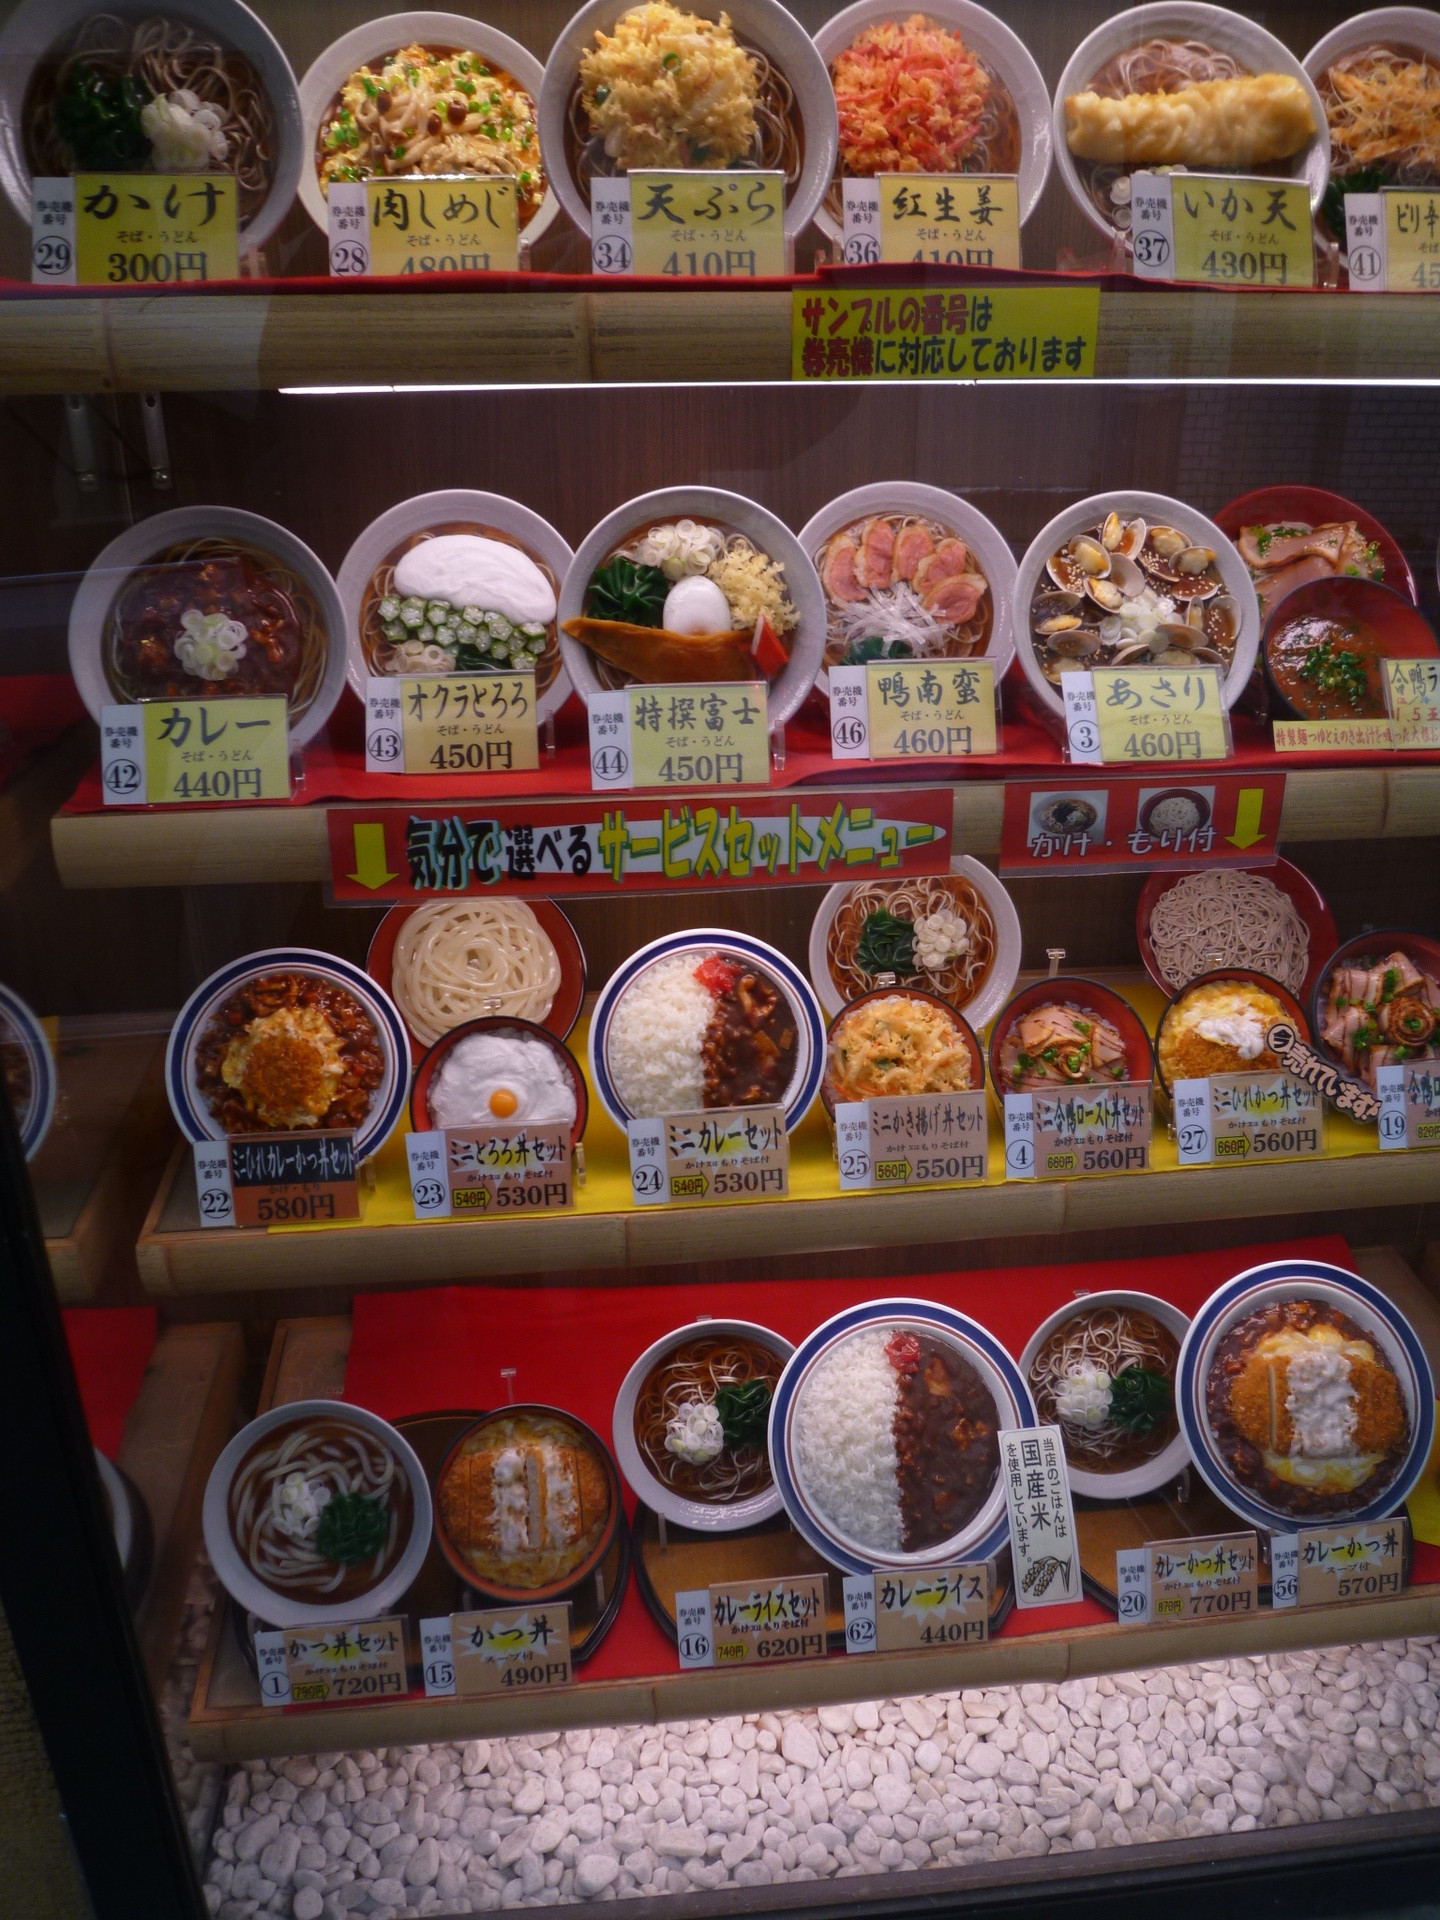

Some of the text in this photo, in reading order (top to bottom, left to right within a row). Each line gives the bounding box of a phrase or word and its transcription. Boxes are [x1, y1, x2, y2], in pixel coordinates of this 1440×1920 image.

[83, 182, 225, 226] かけ
[373, 187, 509, 231] 肉しめじ
[594, 201, 630, 213] 券売機
[637, 181, 775, 225] 天ぷら
[846, 201, 879, 212] 券売機
[893, 185, 1003, 226] 紅生姜
[1135, 196, 1167, 209] 券売機
[1183, 187, 1297, 232] いか天
[42, 214, 66, 225] 番号
[337, 218, 360, 230] 番号
[601, 214, 624, 225] 番号
[852, 213, 873, 224] 番号
[1141, 209, 1161, 221] 番号
[116, 230, 199, 243] そば・うどん
[406, 234, 481, 247] そば・うどん
[670, 229, 747, 242] そば・うどん
[916, 228, 986, 241] そば・うどん
[1209, 229, 1279, 244] そば・うどん
[37, 243, 71, 269] 29
[335, 248, 367, 273] 28
[598, 243, 630, 268] 34
[850, 240, 879, 264] 36
[1137, 237, 1166, 261] 37
[108, 252, 206, 282] 300円
[662, 249, 756, 276] 410円
[1201, 250, 1288, 285] 430円
[1353, 252, 1376, 276] 41
[802, 294, 992, 336] サンプルの番号は
[802, 336, 1087, 377] 券売機に対応しております
[832, 686, 863, 697] 券売機
[878, 668, 981, 707] 鴨南蛮
[1067, 691, 1095, 701] 券売機
[1105, 675, 1206, 711] あさり
[408, 682, 528, 723] オクラとろろ
[635, 693, 760, 732] 特撰富士
[838, 697, 858, 707] 番号
[1073, 701, 1093, 712] 番号
[374, 709, 395, 720] 番号
[592, 713, 624, 724] 券売機
[900, 709, 965, 721] そば・うどん
[1128, 714, 1192, 726] そば・うどん
[157, 707, 271, 748] カレー
[437, 724, 505, 736] そば・うどん
[598, 724, 618, 735] 番号
[836, 722, 863, 745] 46
[110, 738, 133, 749] 番号
[370, 734, 399, 757] 43
[665, 736, 735, 747] そば・うどん
[893, 726, 973, 755] 460円
[1123, 730, 1202, 759] 460円
[181, 750, 252, 762] そば・うどん
[430, 740, 513, 770] 450円
[595, 751, 624, 774] 44
[108, 764, 139, 789] 42
[658, 753, 743, 783] 450円
[173, 767, 262, 798] 440円
[406, 800, 936, 891] 気分で選べるサービスセットメニュー
[1031, 826, 1217, 858] かけ・もり付
[1178, 1097, 1205, 1107] 券売機
[1183, 1107, 1201, 1116] 番号
[840, 1121, 868, 1132] 券売機
[873, 1102, 983, 1138] ミニかき揚げ丼セット
[1013, 1122, 1031, 1132] 番号
[1383, 1116, 1404, 1136] 19
[669, 1116, 782, 1157] ミニカレーセット
[845, 1132, 863, 1141] 番号
[1181, 1129, 1204, 1150] 27
[1253, 1128, 1317, 1152] 560円
[451, 1132, 566, 1167] ミニとろろ丼セット
[637, 1148, 655, 1157] 番号
[1083, 1146, 1146, 1170] 560円
[203, 1170, 222, 1179] 番号
[417, 1162, 435, 1171] 番号
[843, 1154, 868, 1176] 25
[916, 1154, 984, 1179] 550円
[635, 1170, 662, 1191] 24
[714, 1168, 783, 1194] 530円
[202, 1192, 229, 1213] 22
[417, 1184, 443, 1205] 23
[497, 1182, 567, 1207] 530円
[258, 1193, 335, 1221] 580円
[1021, 1438, 1051, 1531] 国産米
[1043, 1437, 1067, 1538] 当店のごはんは
[1006, 1442, 1032, 1563] を使用しています。
[1302, 1527, 1399, 1564] カレーかつ丼
[1155, 1546, 1255, 1579] カレーかつ丼セット
[1279, 1560, 1294, 1569] 番号
[1124, 1575, 1141, 1583] 番号
[1275, 1578, 1297, 1598] 56
[1338, 1573, 1398, 1596] 570円
[880, 1573, 984, 1610] カレーライス
[1189, 1590, 1251, 1614] 770円
[714, 1587, 820, 1627] カレーライスセット
[851, 1601, 868, 1610] 番号
[1121, 1594, 1144, 1613] 20
[471, 1614, 553, 1648] かつ丼
[850, 1621, 873, 1641] 62
[920, 1620, 984, 1643] 440円
[289, 1631, 399, 1659] かつ丼セット
[682, 1637, 707, 1656] 16
[757, 1634, 822, 1658] 620円
[333, 1672, 401, 1696] 720円
[430, 1665, 454, 1684] 15
[501, 1662, 567, 1686] 490円
